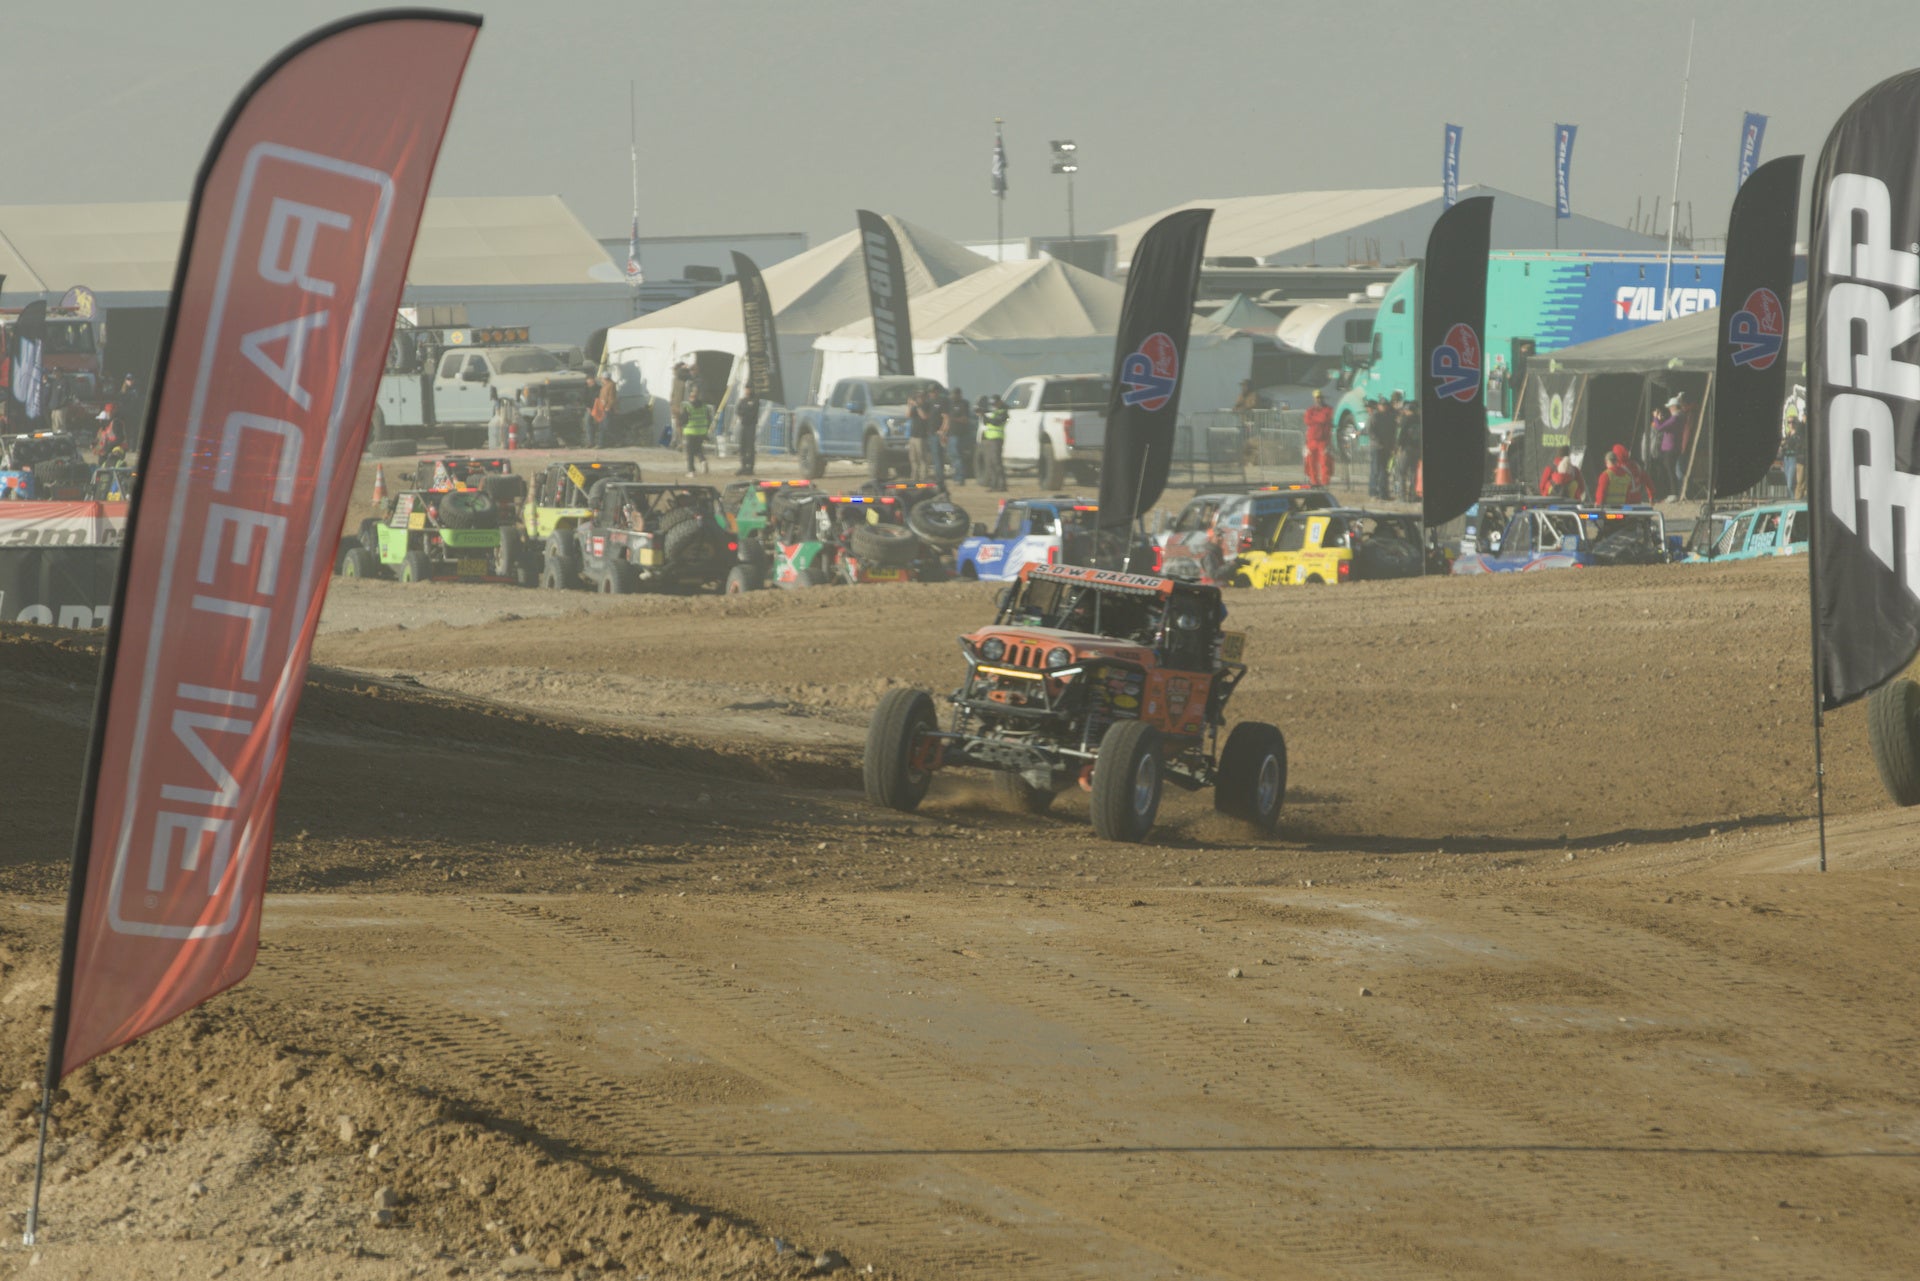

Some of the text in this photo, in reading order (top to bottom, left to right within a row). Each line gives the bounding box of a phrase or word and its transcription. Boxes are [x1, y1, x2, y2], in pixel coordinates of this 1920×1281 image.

[1615, 286, 1717, 321] FALKEN
[1729, 310, 1783, 366] VP
[1121, 352, 1176, 406] VP
[1432, 345, 1480, 399] VP
[1827, 172, 1920, 600] PRP
[1096, 571, 1161, 587] RACING
